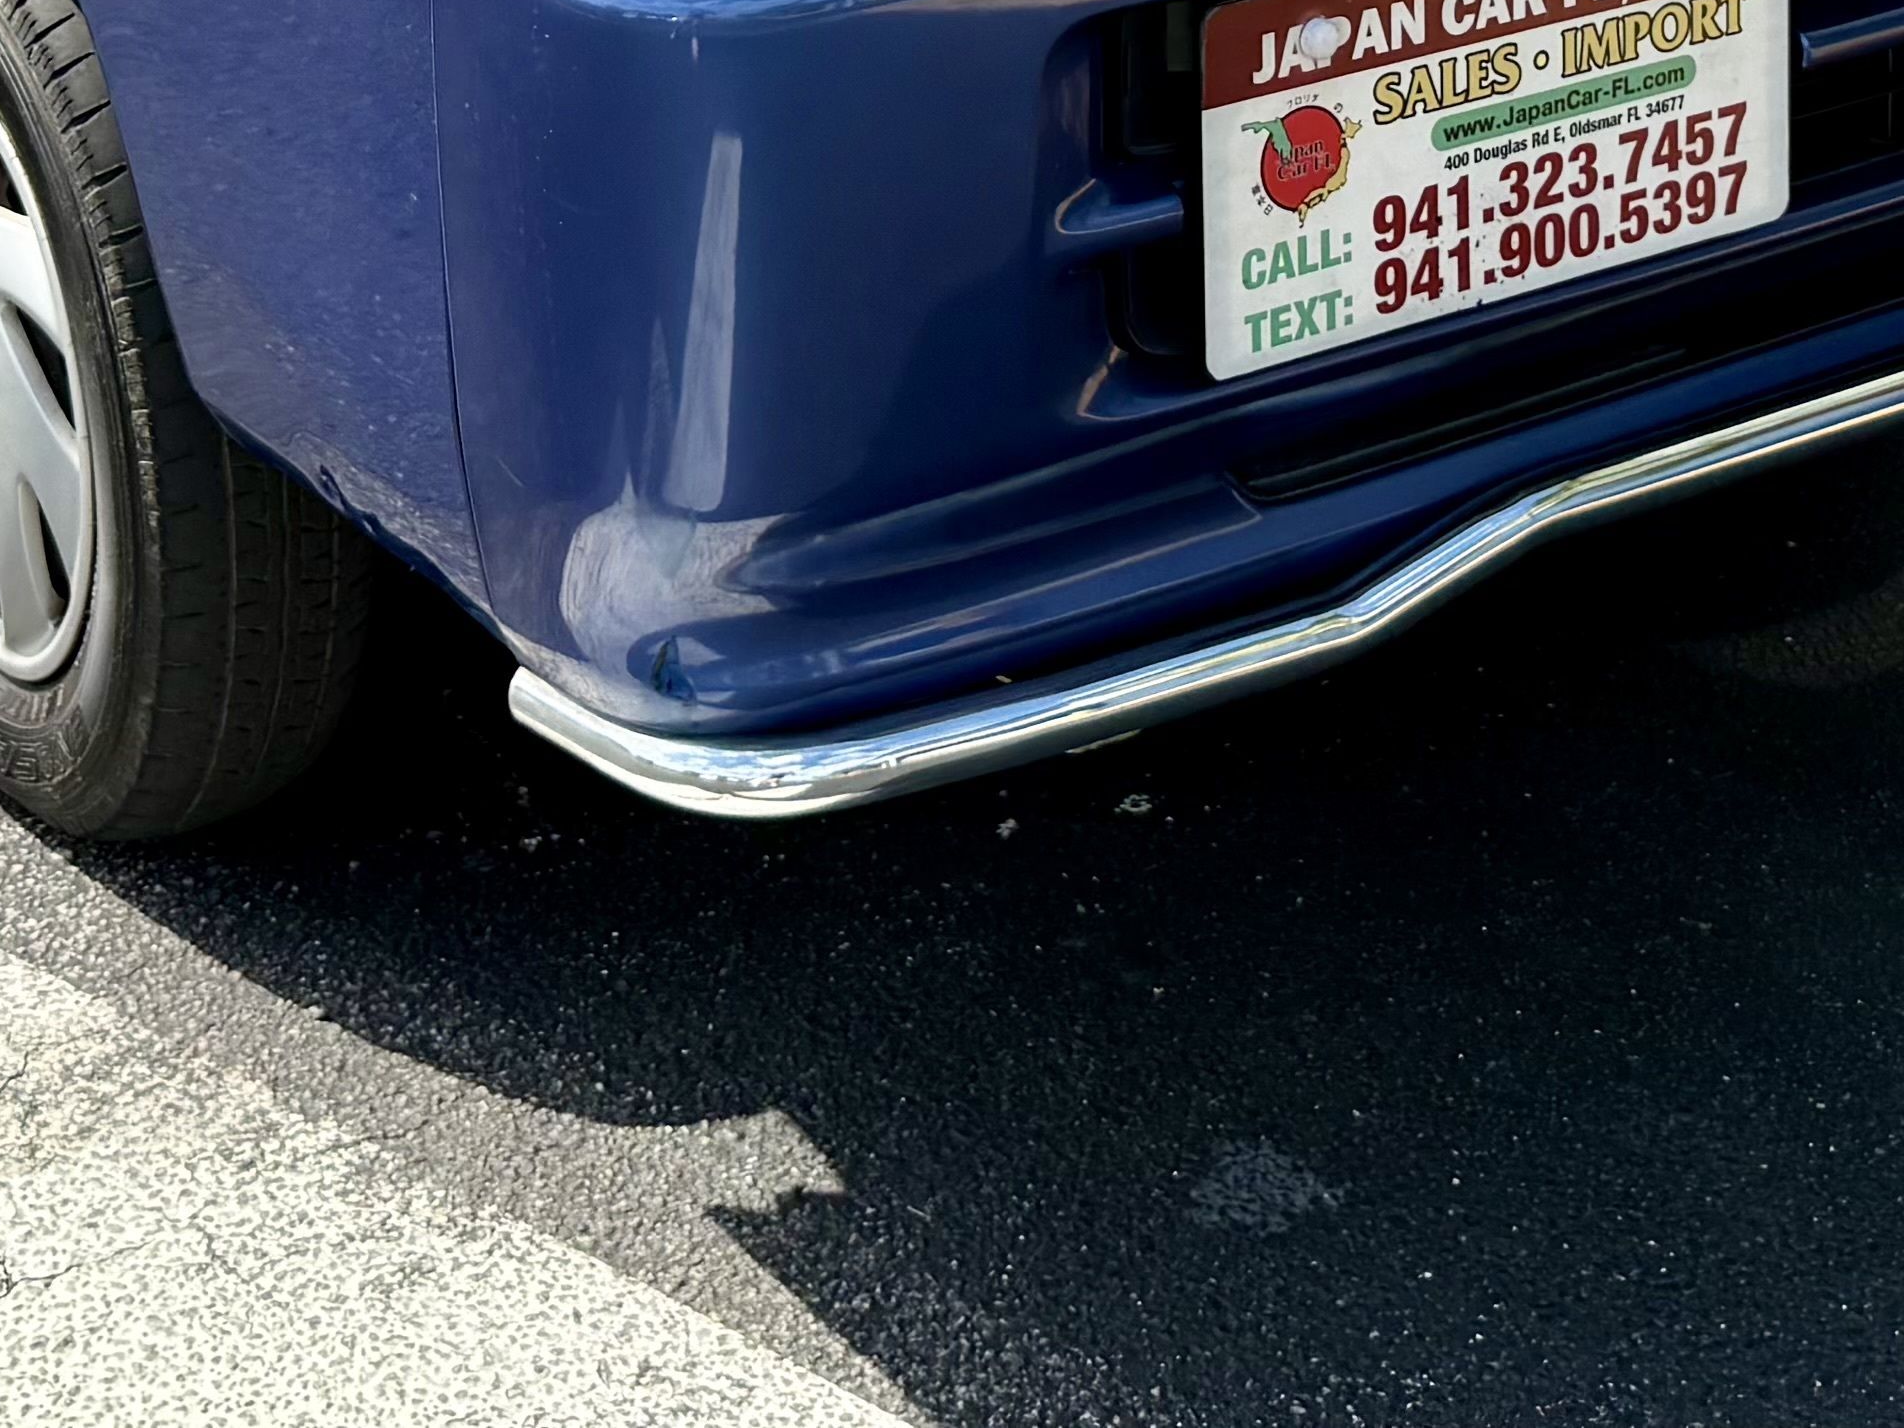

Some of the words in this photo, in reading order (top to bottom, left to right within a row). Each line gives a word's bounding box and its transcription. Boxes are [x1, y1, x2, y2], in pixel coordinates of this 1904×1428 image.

[1373, 43, 1523, 125] SALES
[1443, 66, 1685, 142] www.JapanCar-FL.com
[1443, 152, 1470, 171] 400
[1473, 136, 1528, 161] Douglas
[1531, 129, 1550, 149] Rd
[1553, 125, 1566, 144] E,
[1569, 113, 1623, 138] Oldsmar
[1626, 105, 1642, 124] FL
[1645, 95, 1686, 118] 34677
[1241, 228, 1353, 291] CALL:
[1372, 101, 1748, 252] 941.323.7457
[1244, 287, 1354, 353] TEXT:
[1373, 162, 1748, 315] 941.900.5397
